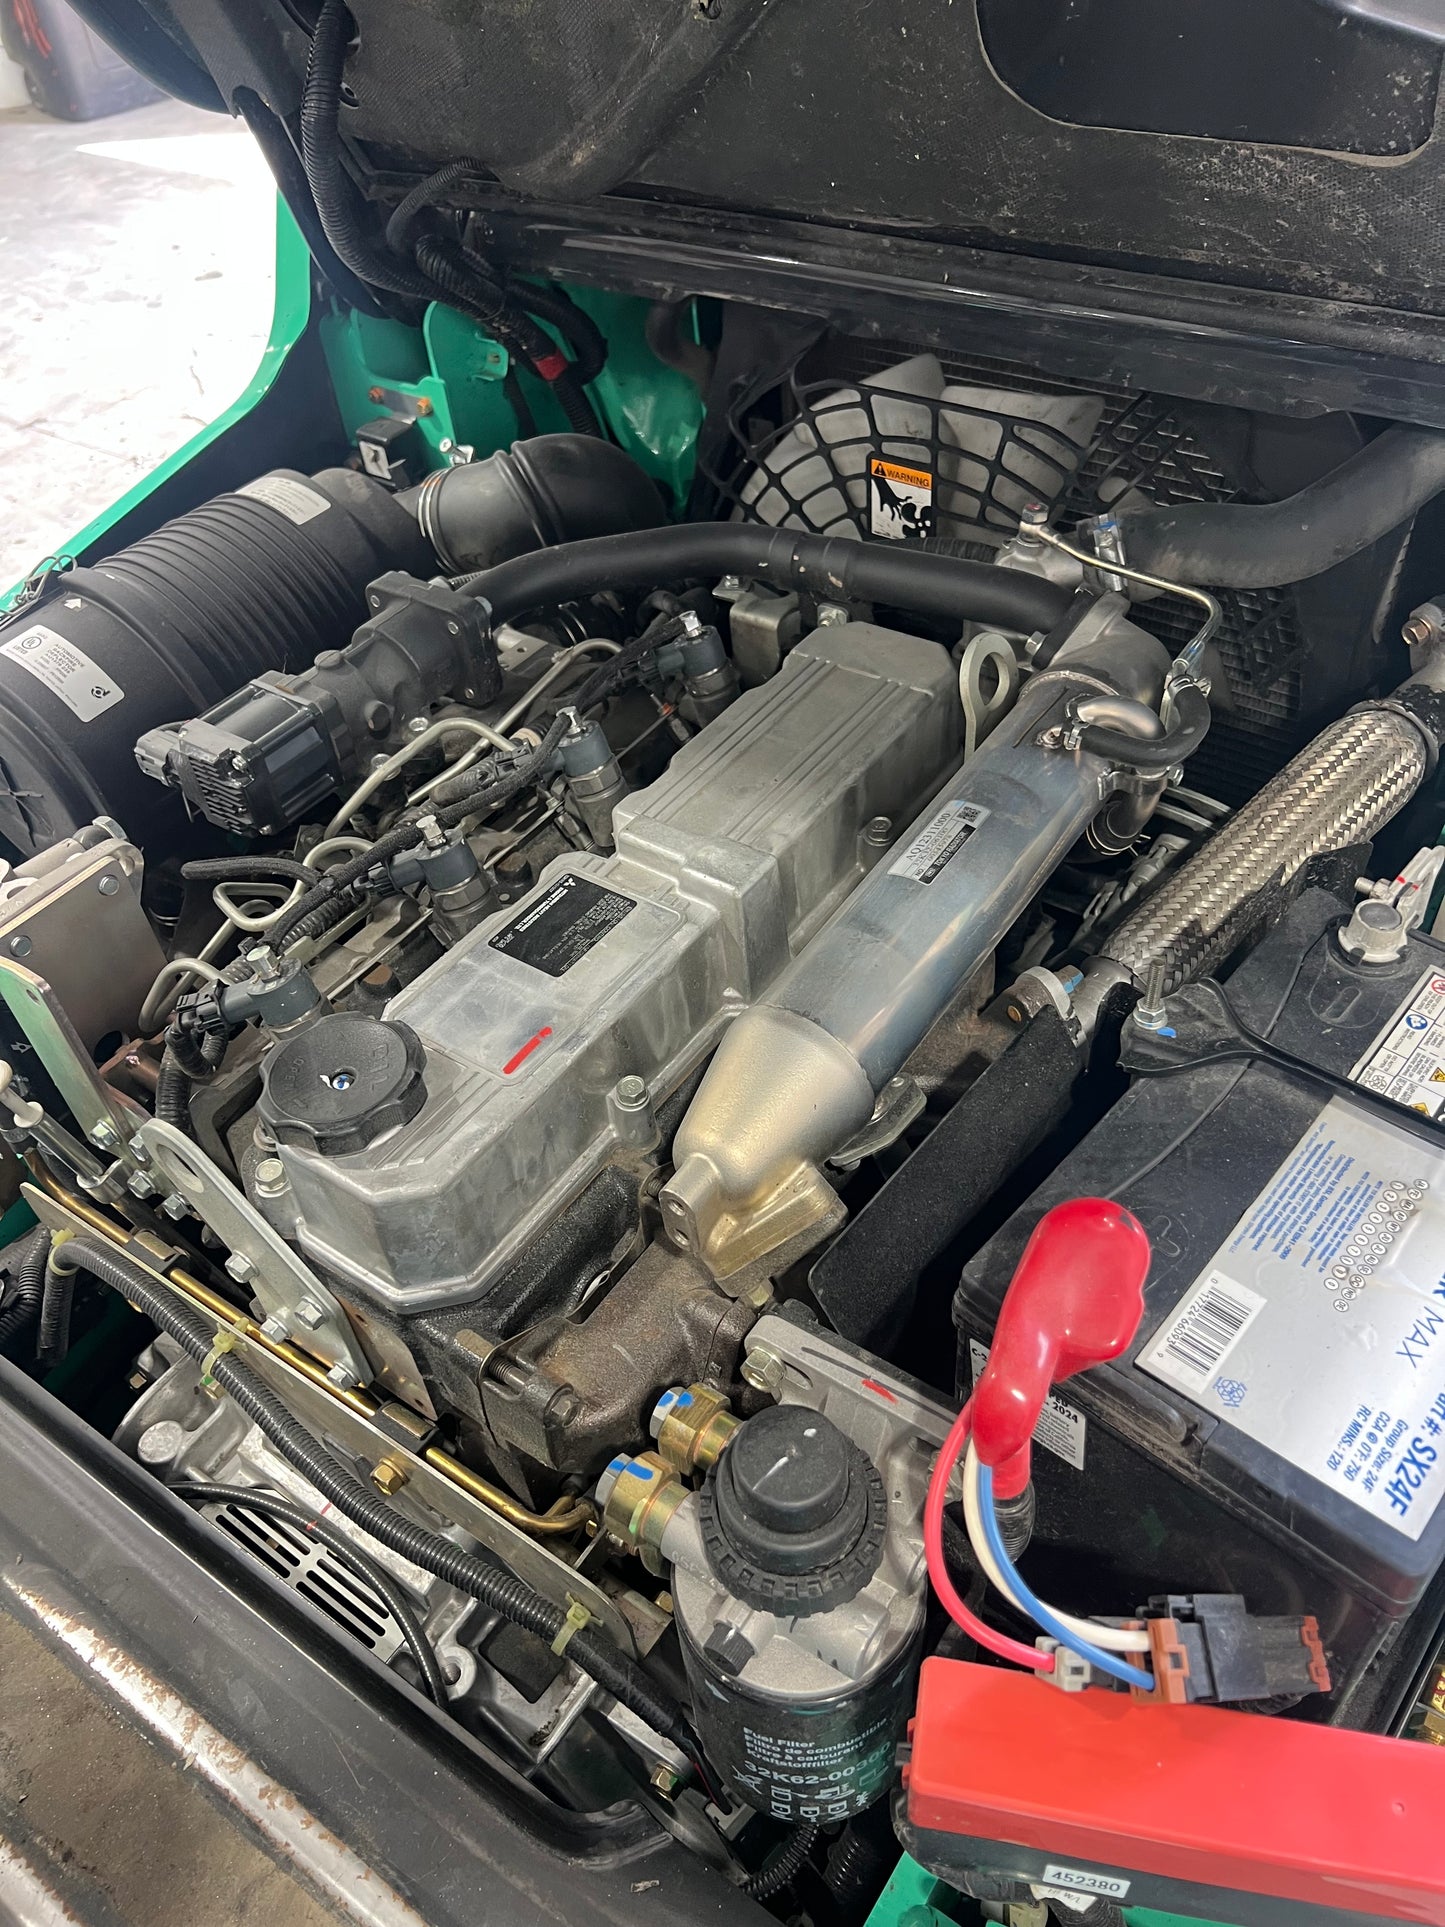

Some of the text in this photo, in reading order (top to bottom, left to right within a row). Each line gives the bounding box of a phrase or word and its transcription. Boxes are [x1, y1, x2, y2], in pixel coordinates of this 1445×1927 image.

[887, 469, 929, 487] WARNING
[935, 831, 967, 866] TOKYO RADIATOR
[517, 888, 569, 932] MITSUBISHI HEAVY INDUSTRIES
[1334, 1157, 1354, 1180] Distributed
[1281, 1200, 1291, 1211] Proof
[1312, 1195, 1327, 1211] Garden
[1297, 1224, 1307, 1233] CA
[1301, 1211, 1316, 1224] Grove,
[1188, 1292, 1209, 1316] 17724
[1167, 1317, 1190, 1345] 66093
[1396, 1306, 1444, 1368] MAX
[1052, 1401, 1079, 1424] 2024
[1356, 1405, 1372, 1422] RC
[1372, 1411, 1390, 1432] CCA
[1366, 1431, 1377, 1443] @
[1326, 1450, 1343, 1470] 120
[1362, 1419, 1408, 1492] Group Size: 24F
[1343, 1459, 1361, 1481] 750
[1384, 1437, 1436, 1515] SX24F
[743, 1734, 780, 1751] Filtro
[806, 1717, 887, 1754] combustible
[743, 1726, 815, 1748] Fuel Filter
[745, 1741, 783, 1759] Filtre
[797, 1740, 863, 1761] carburant
[747, 1748, 843, 1768] Kraftstofffilter
[744, 1741, 890, 1784] 32K62-00300
[1052, 1871, 1121, 1893] 452380
